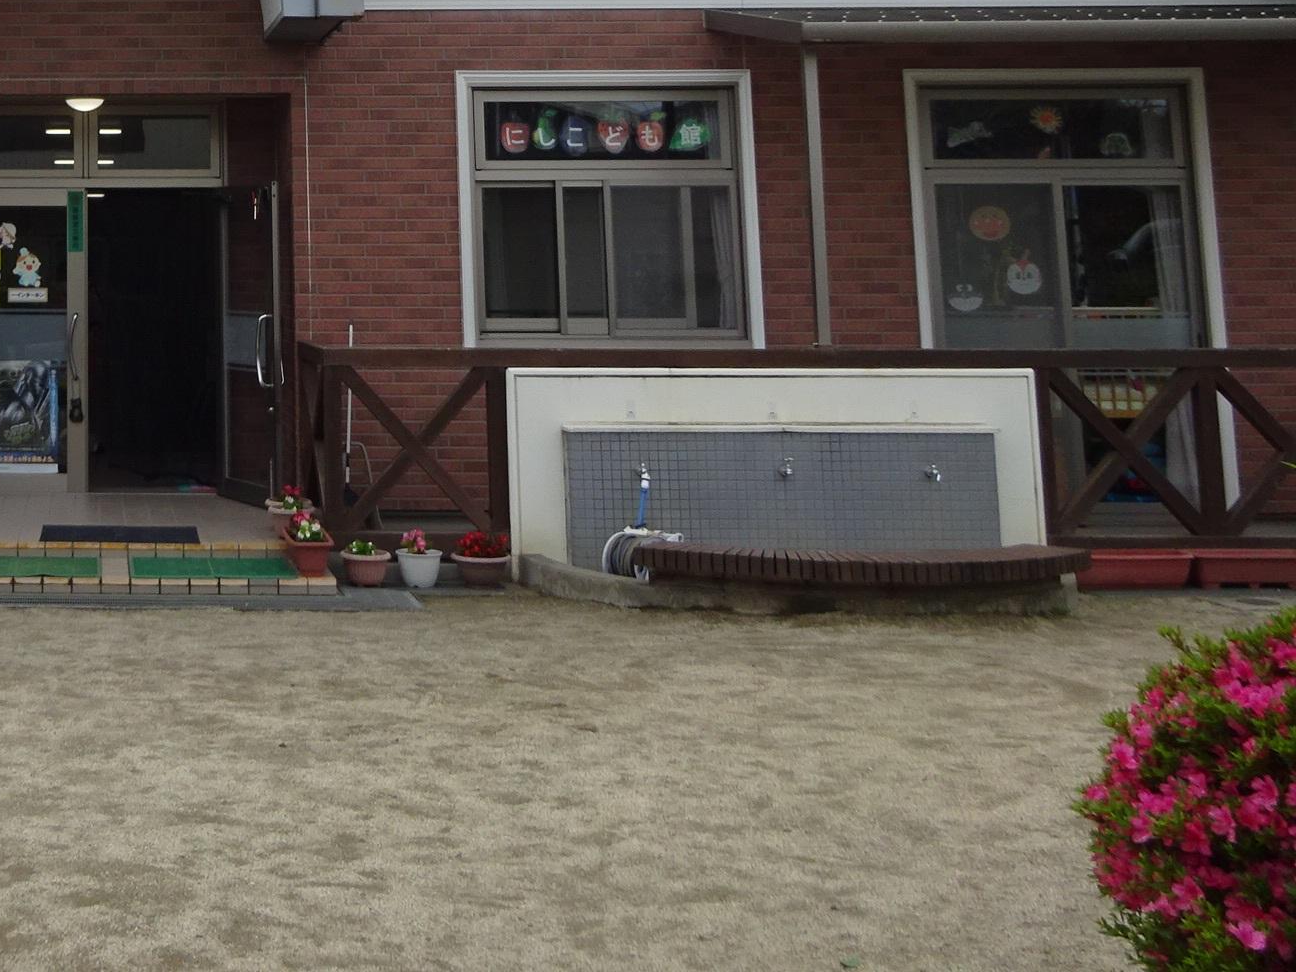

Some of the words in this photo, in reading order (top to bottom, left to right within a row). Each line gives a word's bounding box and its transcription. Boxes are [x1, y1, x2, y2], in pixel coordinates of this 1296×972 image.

[505, 124, 702, 147] にしこども館
